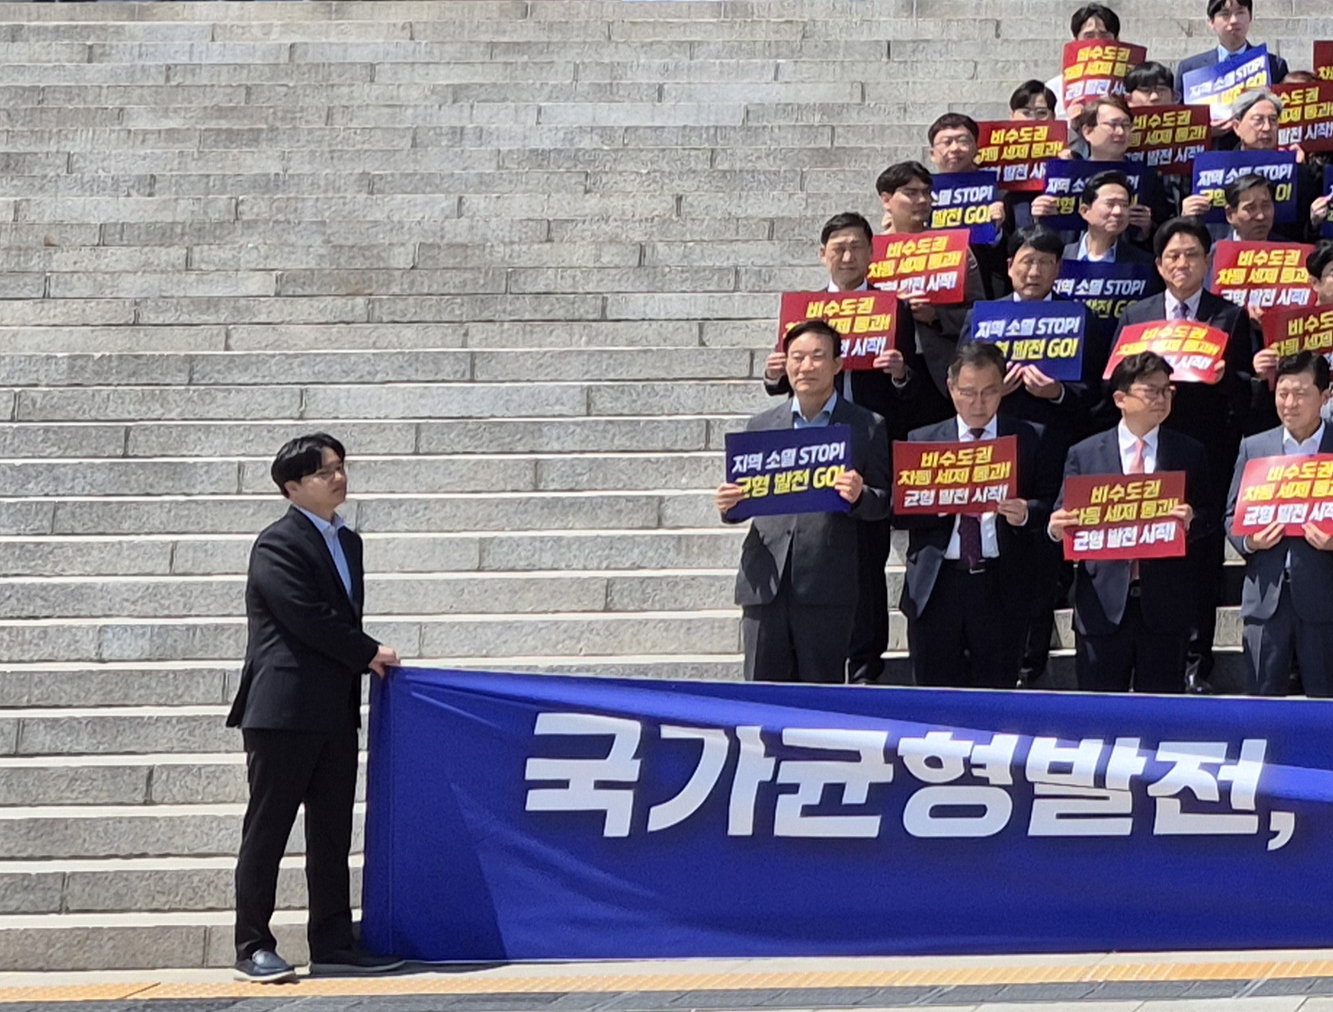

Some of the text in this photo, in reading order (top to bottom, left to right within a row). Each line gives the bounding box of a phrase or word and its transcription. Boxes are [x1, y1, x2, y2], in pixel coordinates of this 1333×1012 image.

[975, 317, 1080, 338] 지역 소멸 STOP!
[1008, 336, 1077, 360] 발전 GO!
[732, 442, 845, 473] 지역 소멸 STOP!
[921, 447, 995, 470] 비수도권
[775, 471, 809, 494] 발전
[899, 463, 1011, 485] 차등 세제 통과!
[905, 485, 1008, 506] 균형 발전 시작!
[1091, 481, 1161, 503] 비수도권
[1244, 484, 1276, 502] 차등
[1276, 481, 1312, 499] 세제
[1105, 503, 1138, 521] 세제
[1243, 504, 1276, 528] 균형
[1273, 503, 1308, 525] 발전
[1074, 521, 1176, 551] 균형 발전 시작!
[526, 713, 1294, 850] 국가균형발전,
